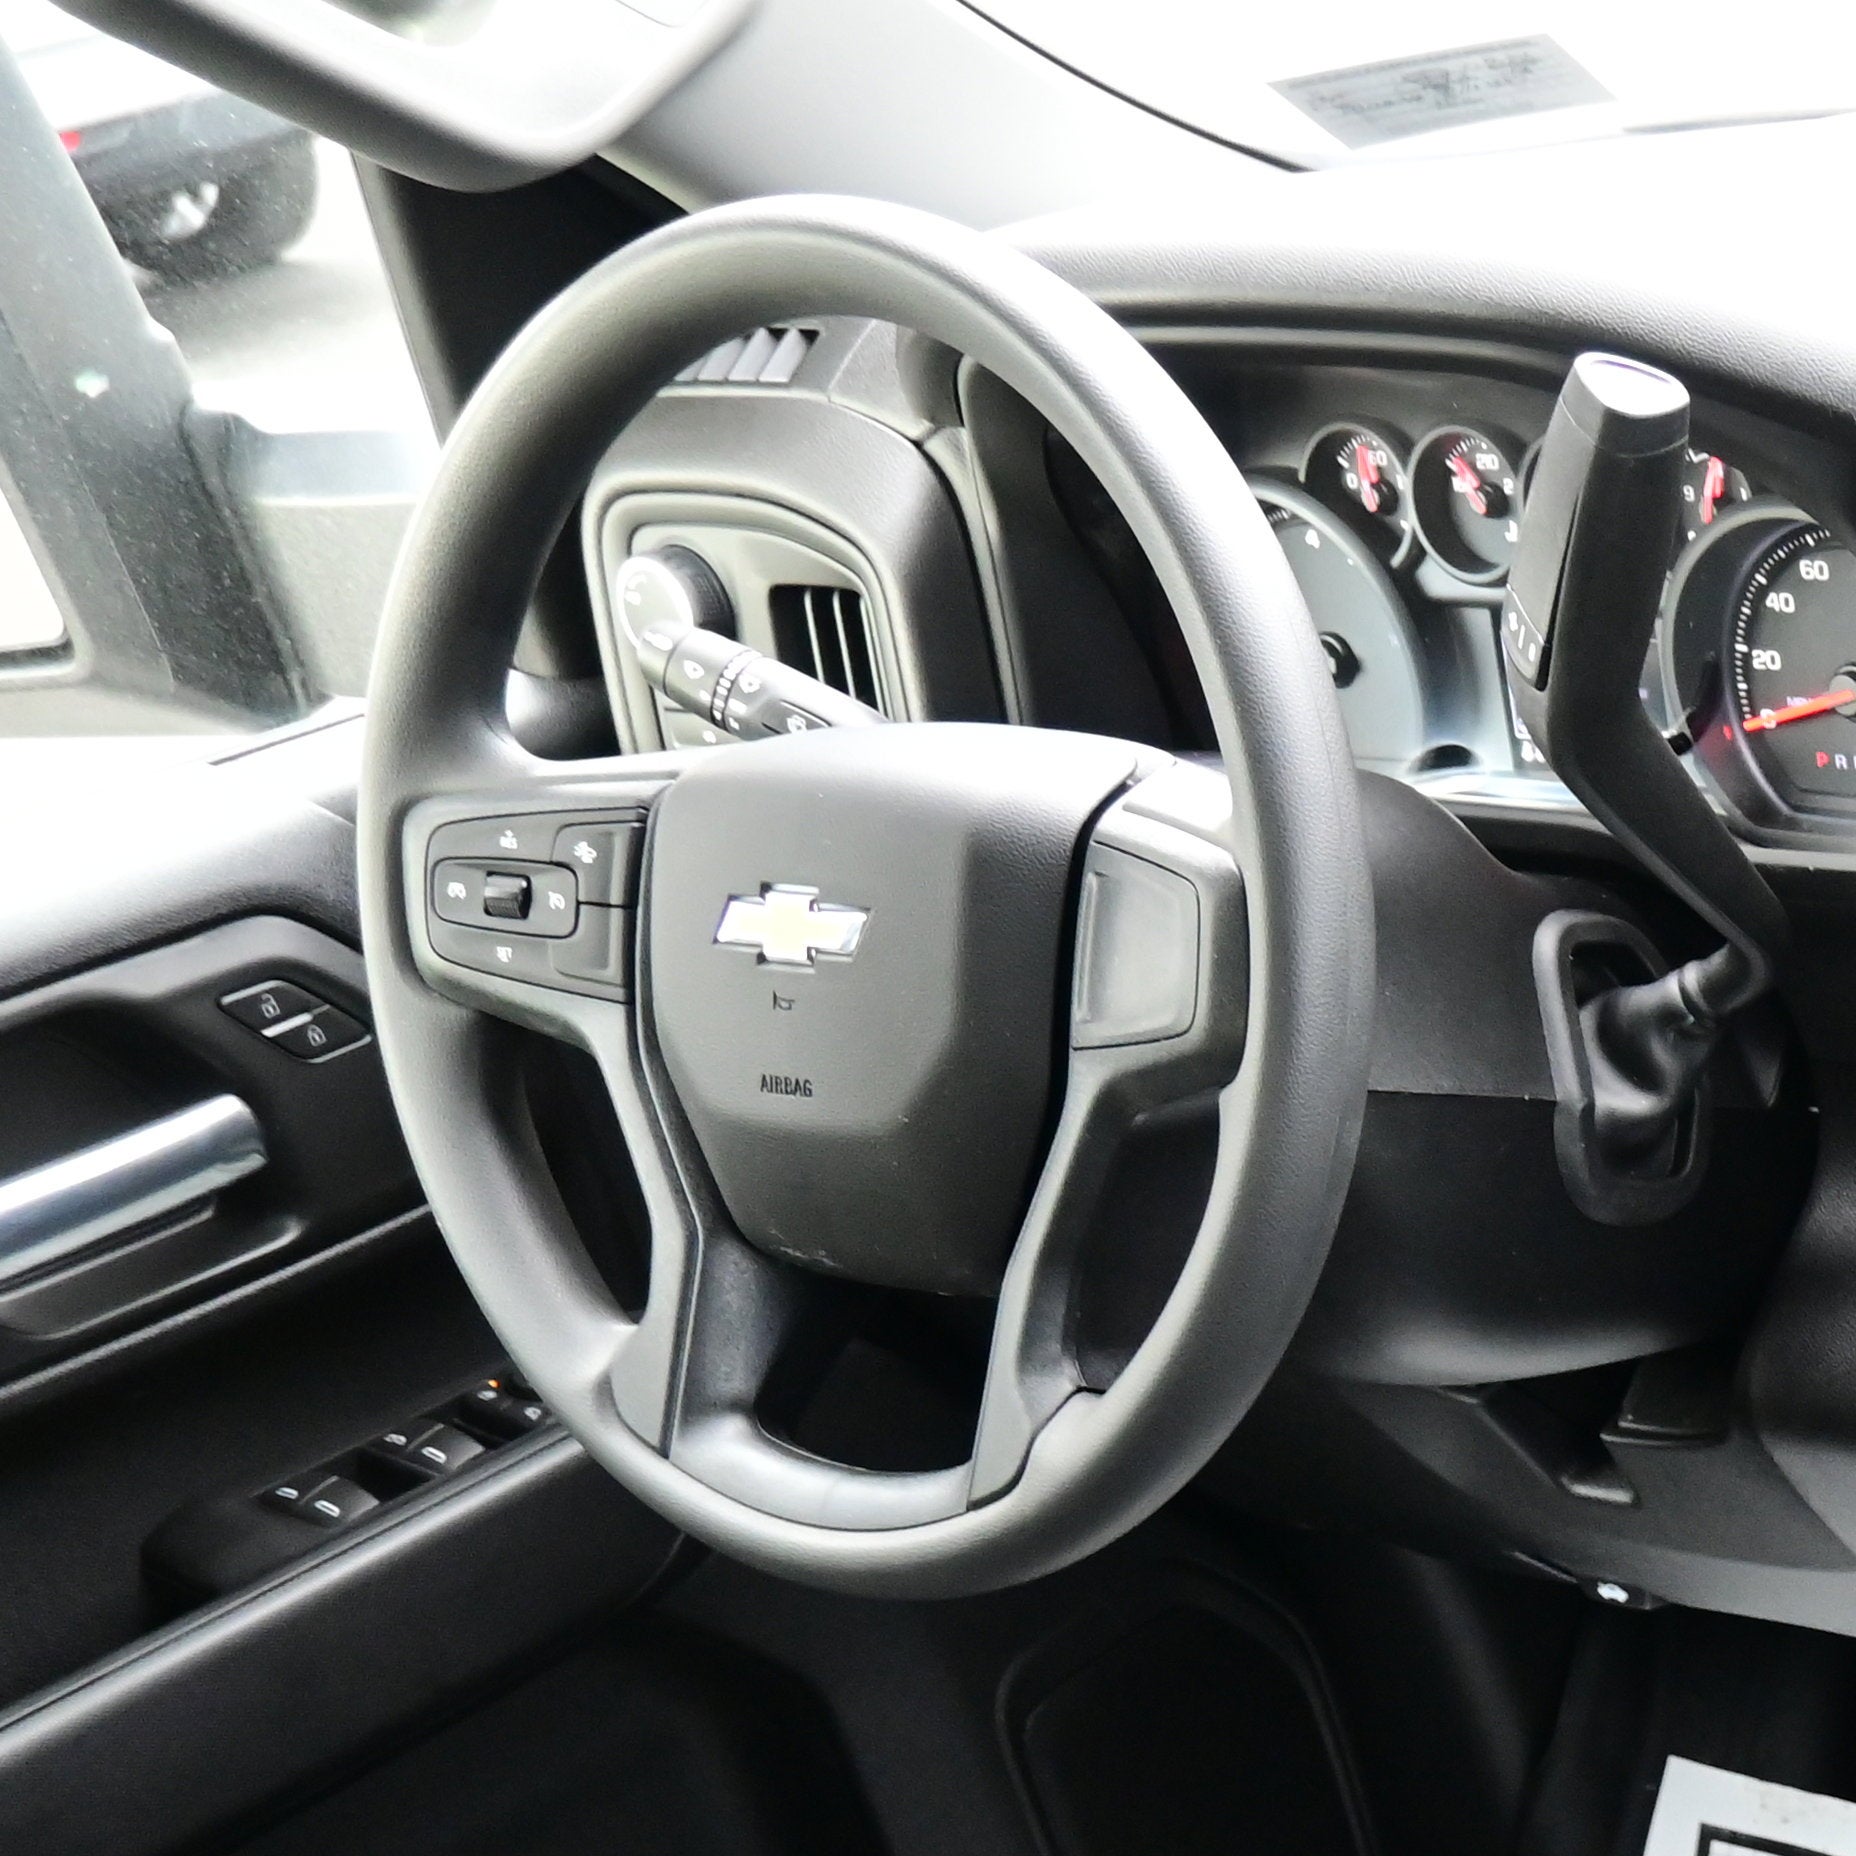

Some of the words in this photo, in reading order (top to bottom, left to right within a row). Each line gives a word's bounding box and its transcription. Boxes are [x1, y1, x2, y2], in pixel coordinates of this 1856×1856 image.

[1800, 559, 1830, 581] 60
[1765, 591, 1796, 613] 40
[1752, 649, 1782, 671] 20
[1815, 751, 1829, 768] P
[1836, 754, 1848, 769] R
[760, 1073, 813, 1097] AIRBAG
